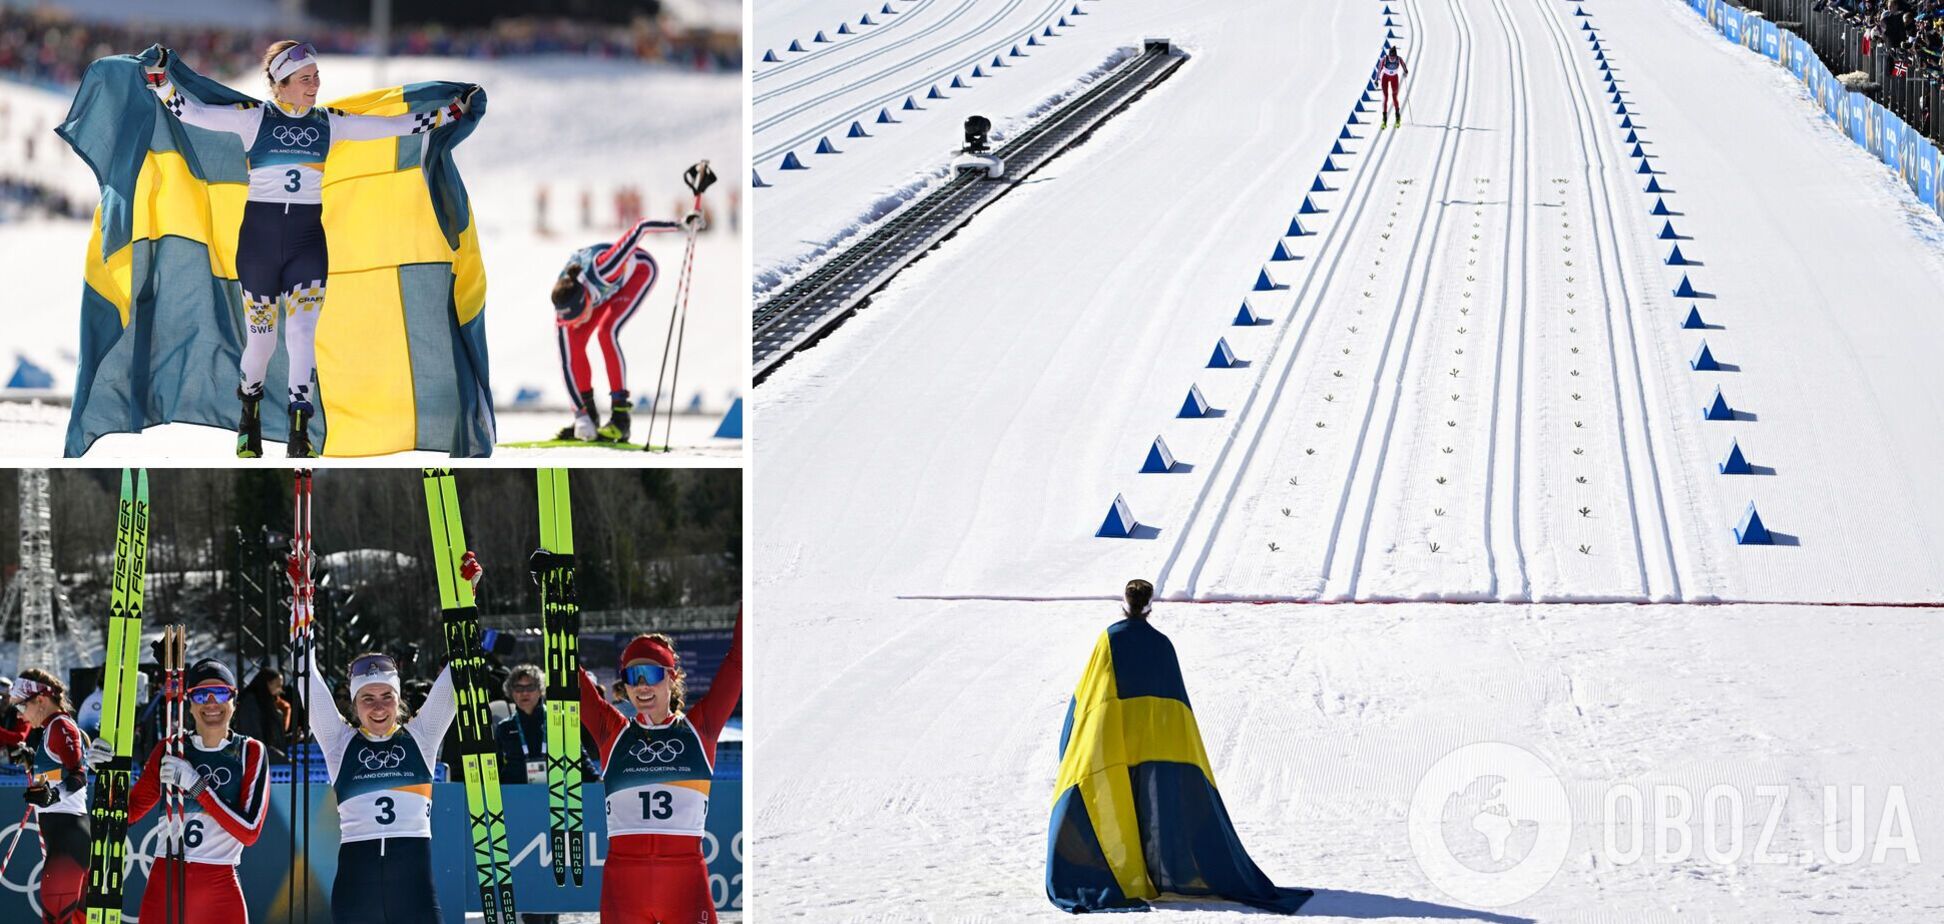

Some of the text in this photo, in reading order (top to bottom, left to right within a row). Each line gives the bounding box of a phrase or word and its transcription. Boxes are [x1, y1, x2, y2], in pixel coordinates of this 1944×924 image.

[284, 169, 301, 193] 3
[250, 325, 273, 334] SWE
[116, 499, 131, 594] FISCHER
[132, 500, 147, 595] FISCHER
[62, 727, 74, 751] LAT
[353, 772, 376, 780] MILANO
[623, 766, 649, 774] MILANO
[375, 797, 397, 825] 3
[638, 791, 673, 820] 13
[184, 819, 204, 849] 6
[555, 836, 564, 874] SPEED
[573, 837, 582, 875] SPEED
[484, 893, 496, 924] PEED
